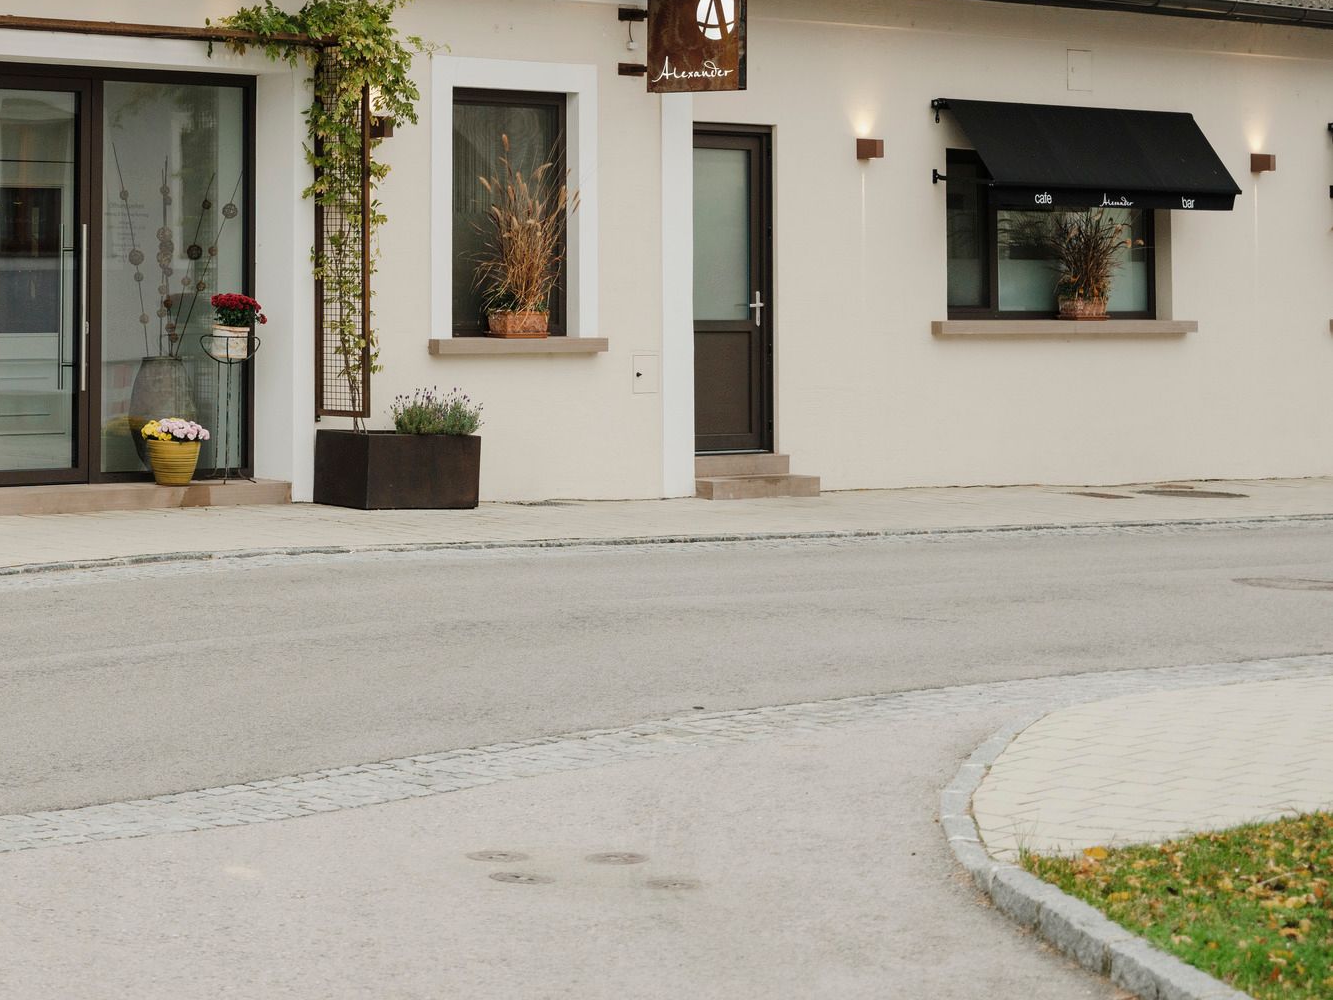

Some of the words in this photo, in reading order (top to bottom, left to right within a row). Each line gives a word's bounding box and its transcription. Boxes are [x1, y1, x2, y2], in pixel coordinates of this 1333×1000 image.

[652, 55, 734, 82] Alexander
[1034, 191, 1053, 204] cafe
[1099, 193, 1134, 207] Alexander
[1181, 196, 1196, 209] bar
